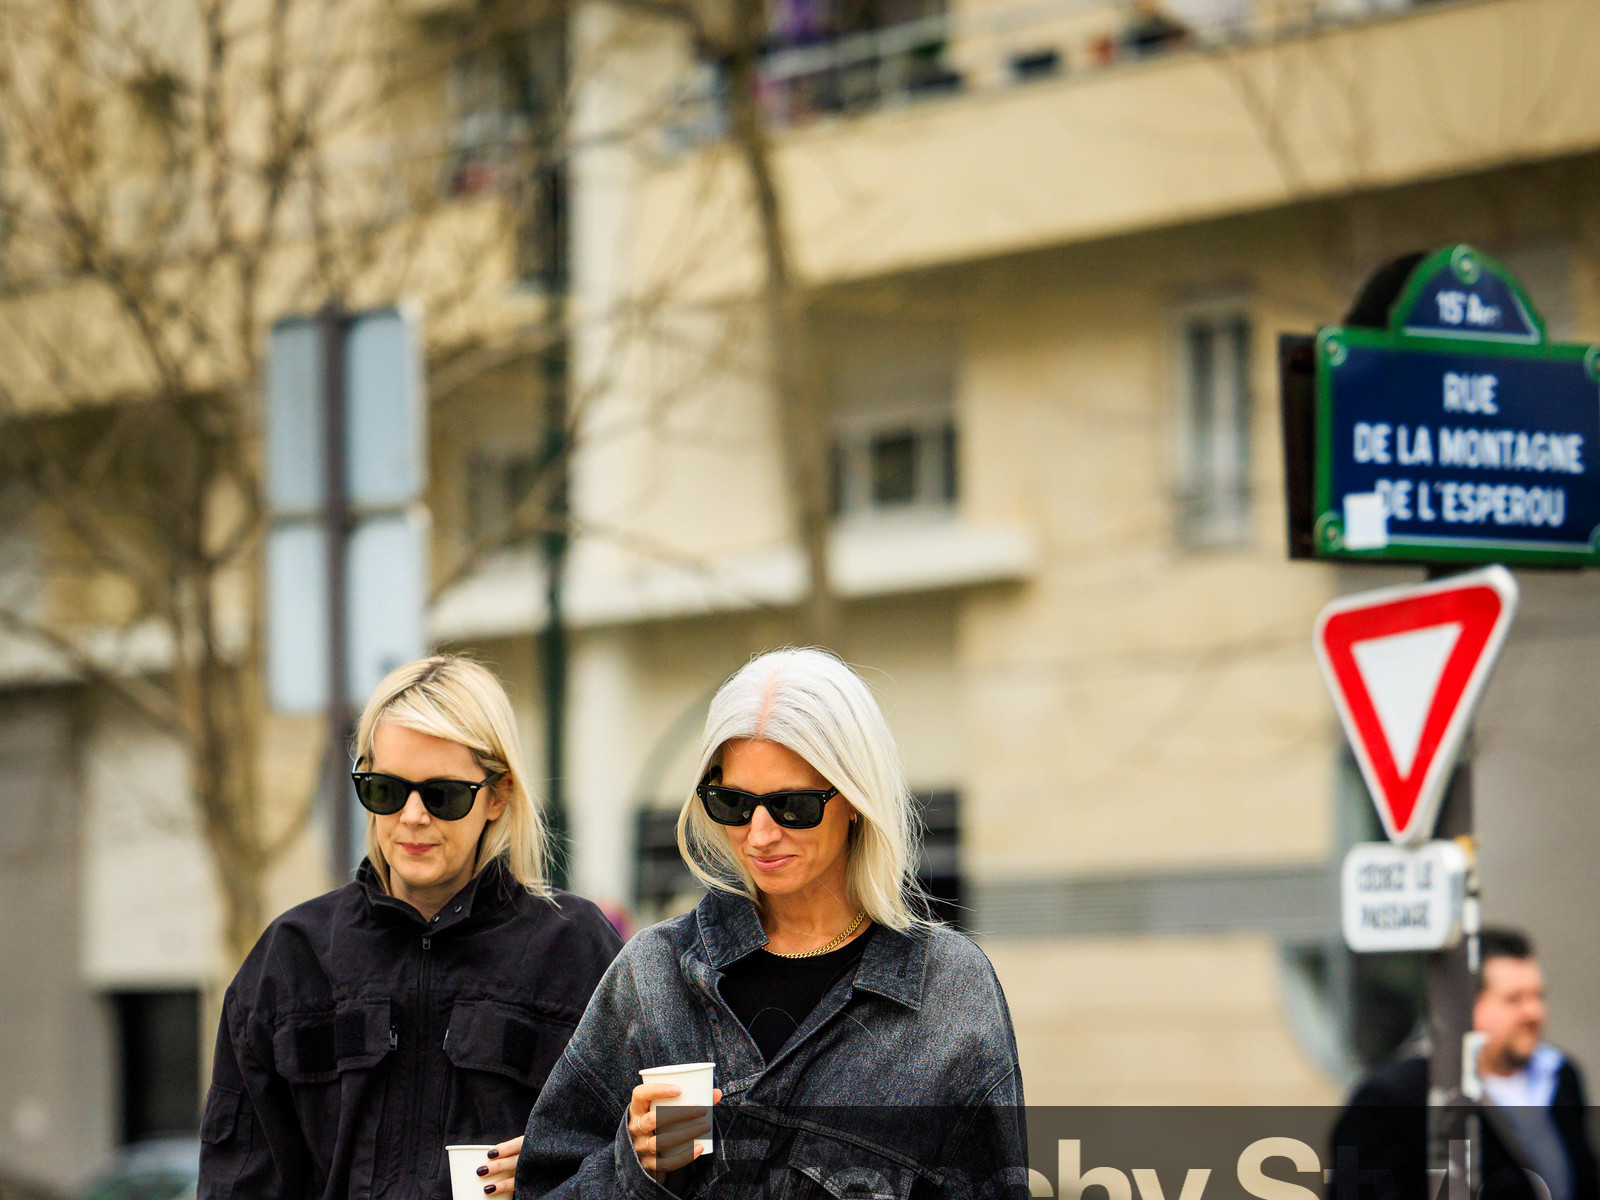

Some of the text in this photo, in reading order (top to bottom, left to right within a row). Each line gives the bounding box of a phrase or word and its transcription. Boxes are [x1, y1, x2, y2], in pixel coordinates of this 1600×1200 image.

[1443, 372, 1498, 415] RUE
[1353, 421, 1585, 474] DE LA MONTAGNE
[1374, 478, 1413, 521] DE
